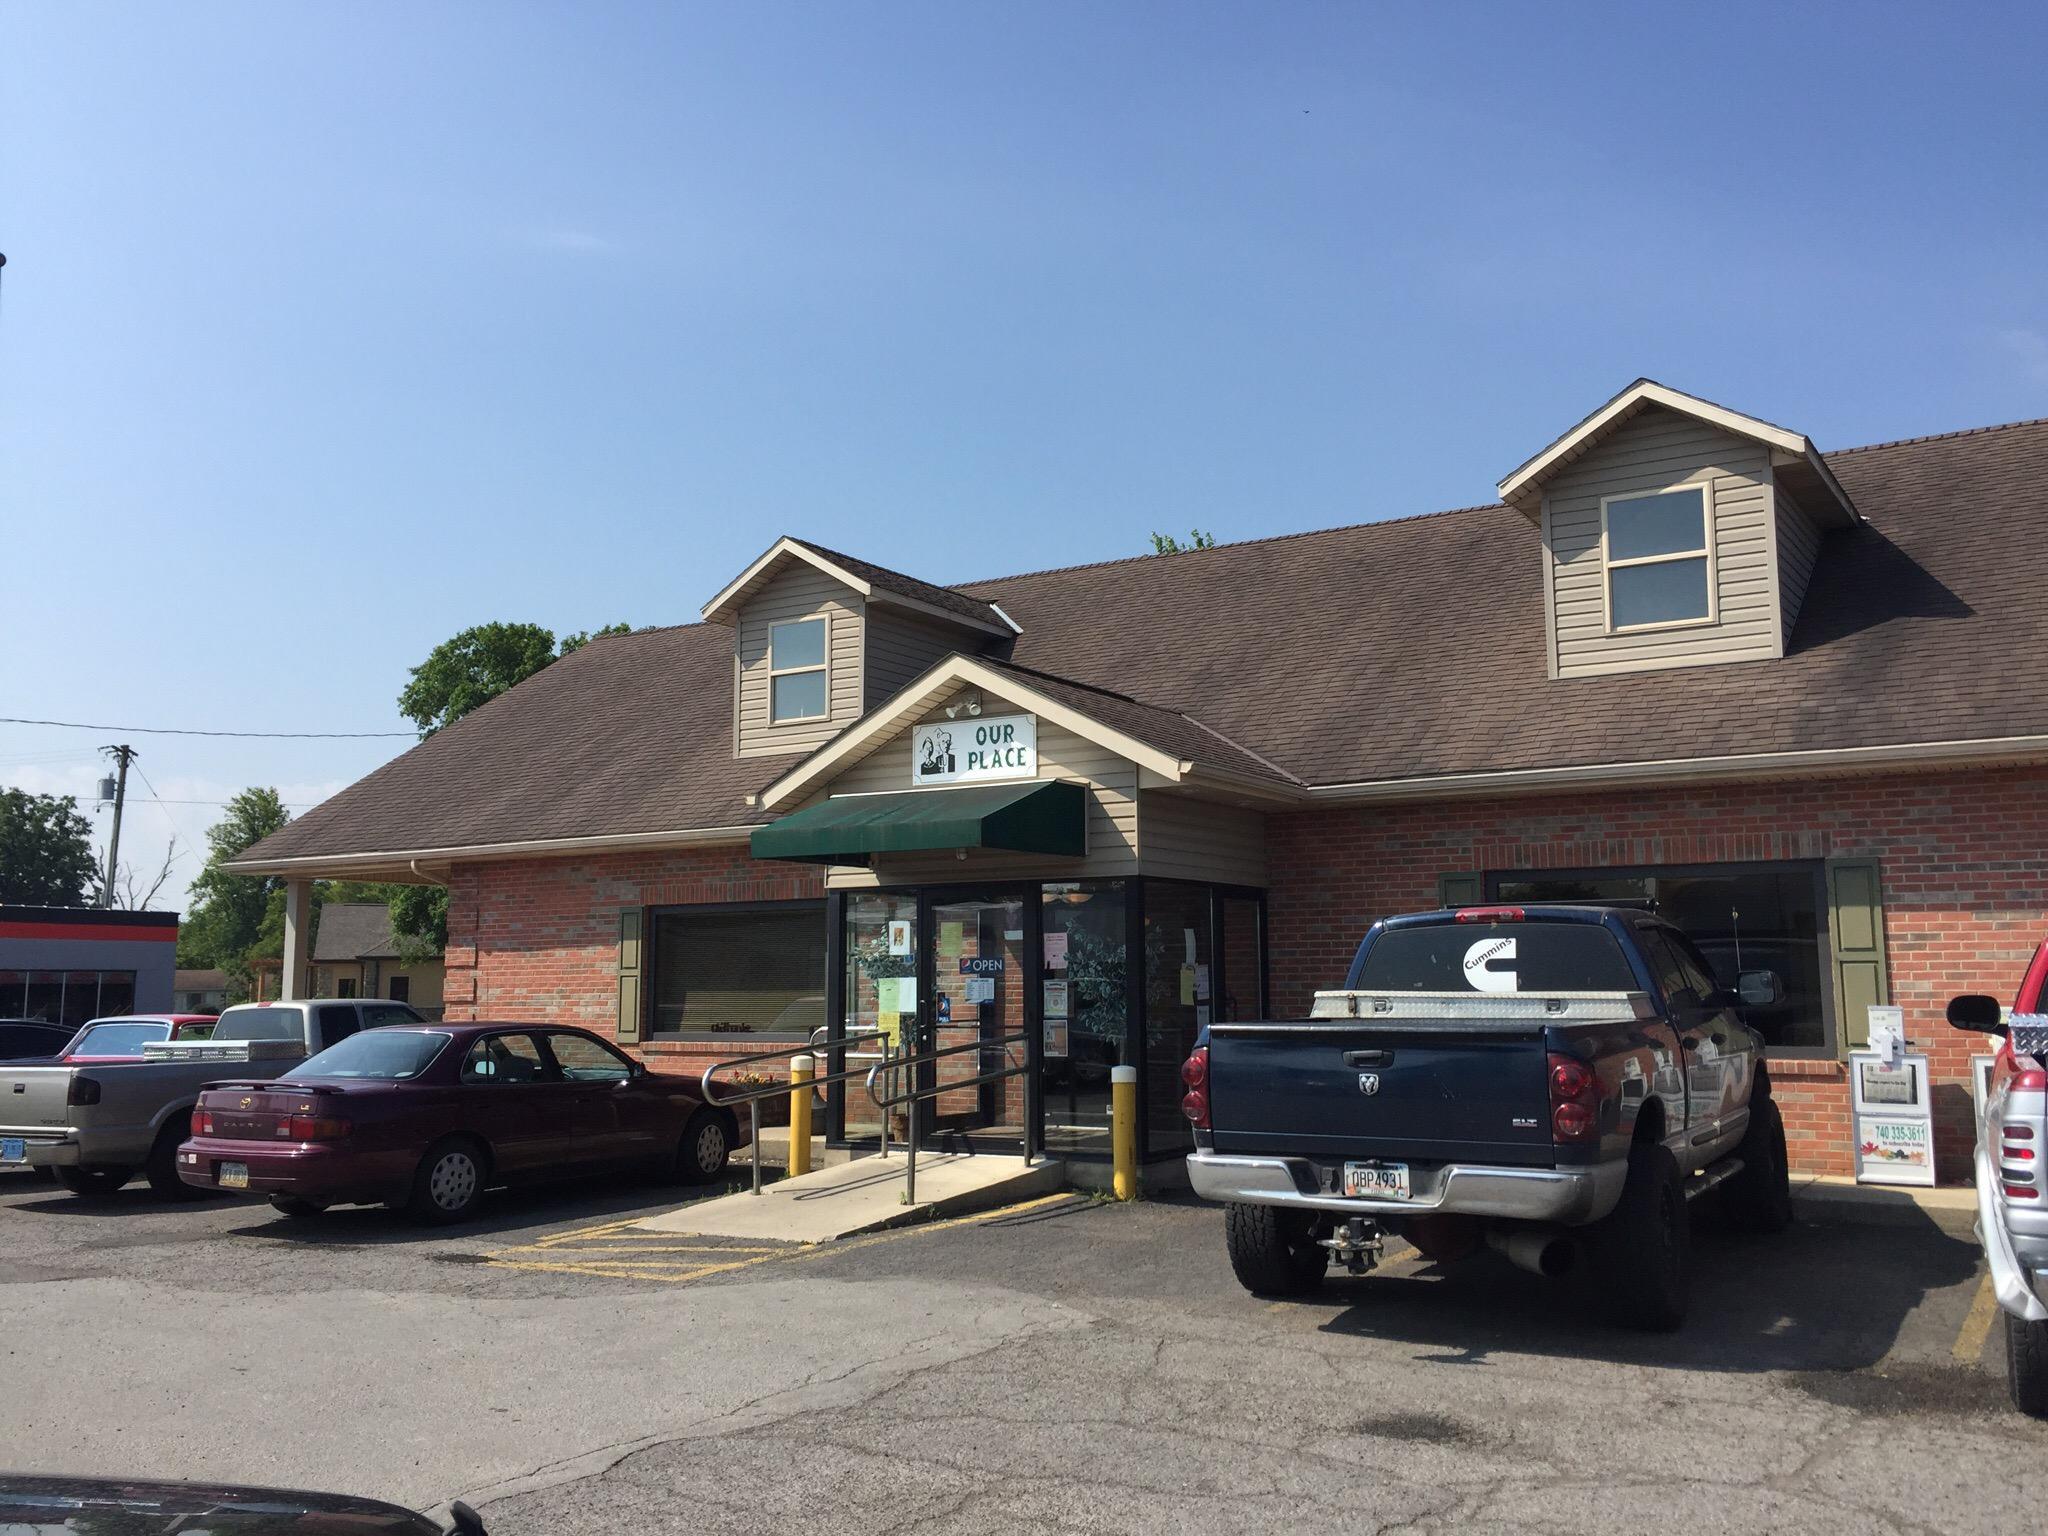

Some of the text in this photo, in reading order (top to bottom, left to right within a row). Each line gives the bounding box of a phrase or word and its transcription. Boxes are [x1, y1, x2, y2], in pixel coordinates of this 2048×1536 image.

[976, 724, 1014, 745] OUR
[968, 747, 1027, 770] PLACE
[1465, 938, 1512, 970] Cummins
[973, 959, 1003, 971] OPEN
[1875, 1125, 1925, 1141] 740 335-3611
